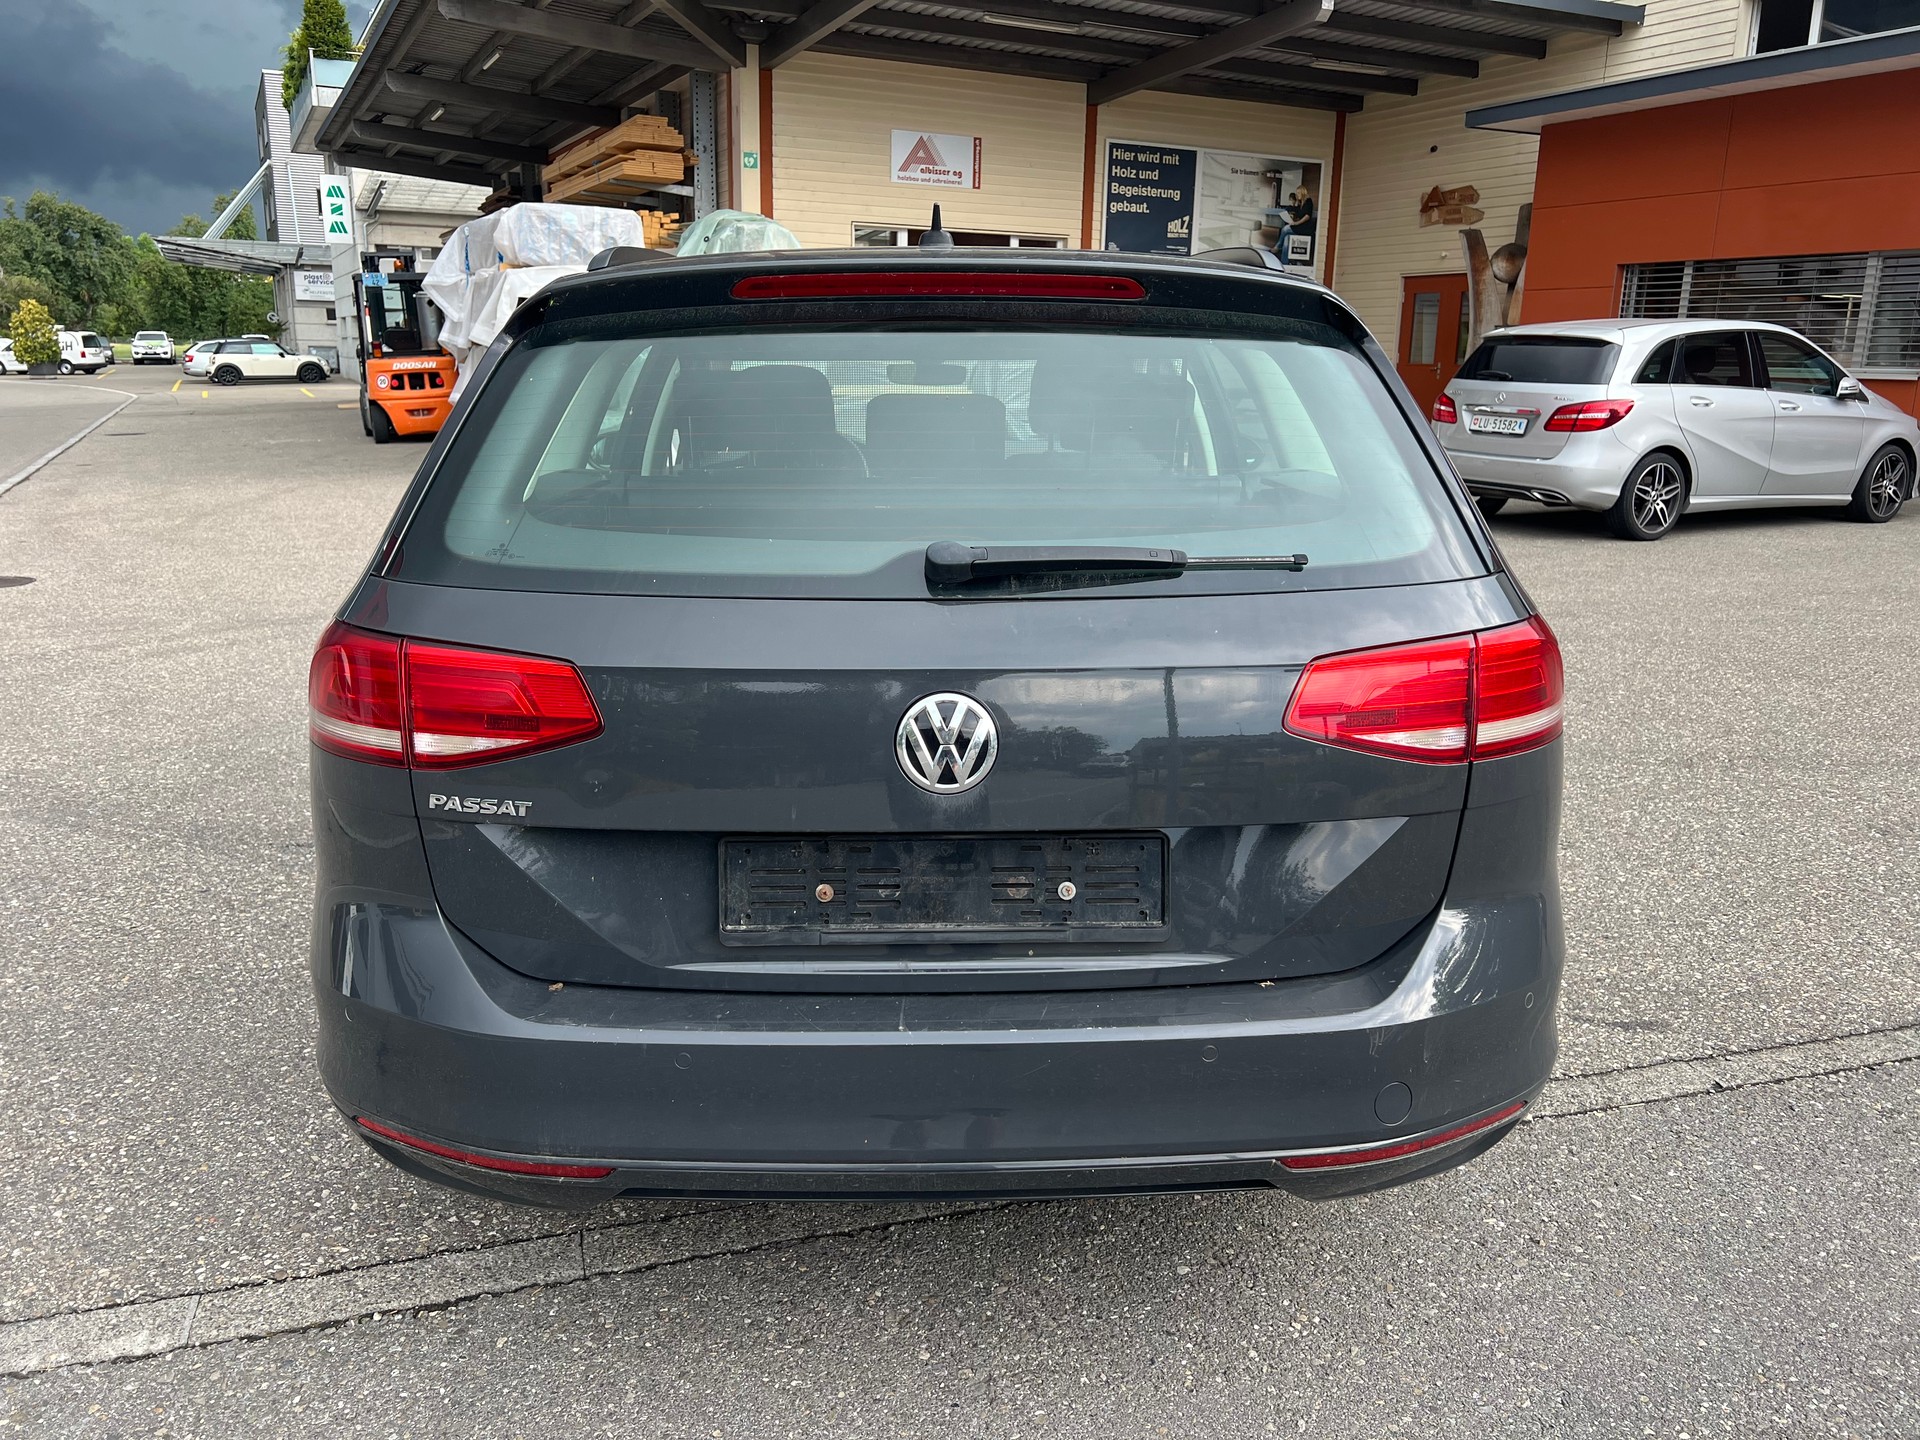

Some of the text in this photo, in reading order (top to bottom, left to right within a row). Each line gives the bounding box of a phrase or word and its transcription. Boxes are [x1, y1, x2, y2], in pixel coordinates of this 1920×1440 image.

[1112, 148, 1180, 165] Hier wird mit
[920, 166, 963, 179] albisser ag
[1111, 165, 1159, 180] Holz und
[932, 177, 963, 185] schreinerei
[1111, 182, 1181, 201] Begeisterung
[1110, 200, 1150, 213] gebaut.
[1167, 215, 1190, 233] HOLZ
[392, 361, 437, 370] DOOSAN
[428, 793, 533, 817] PASSAT
